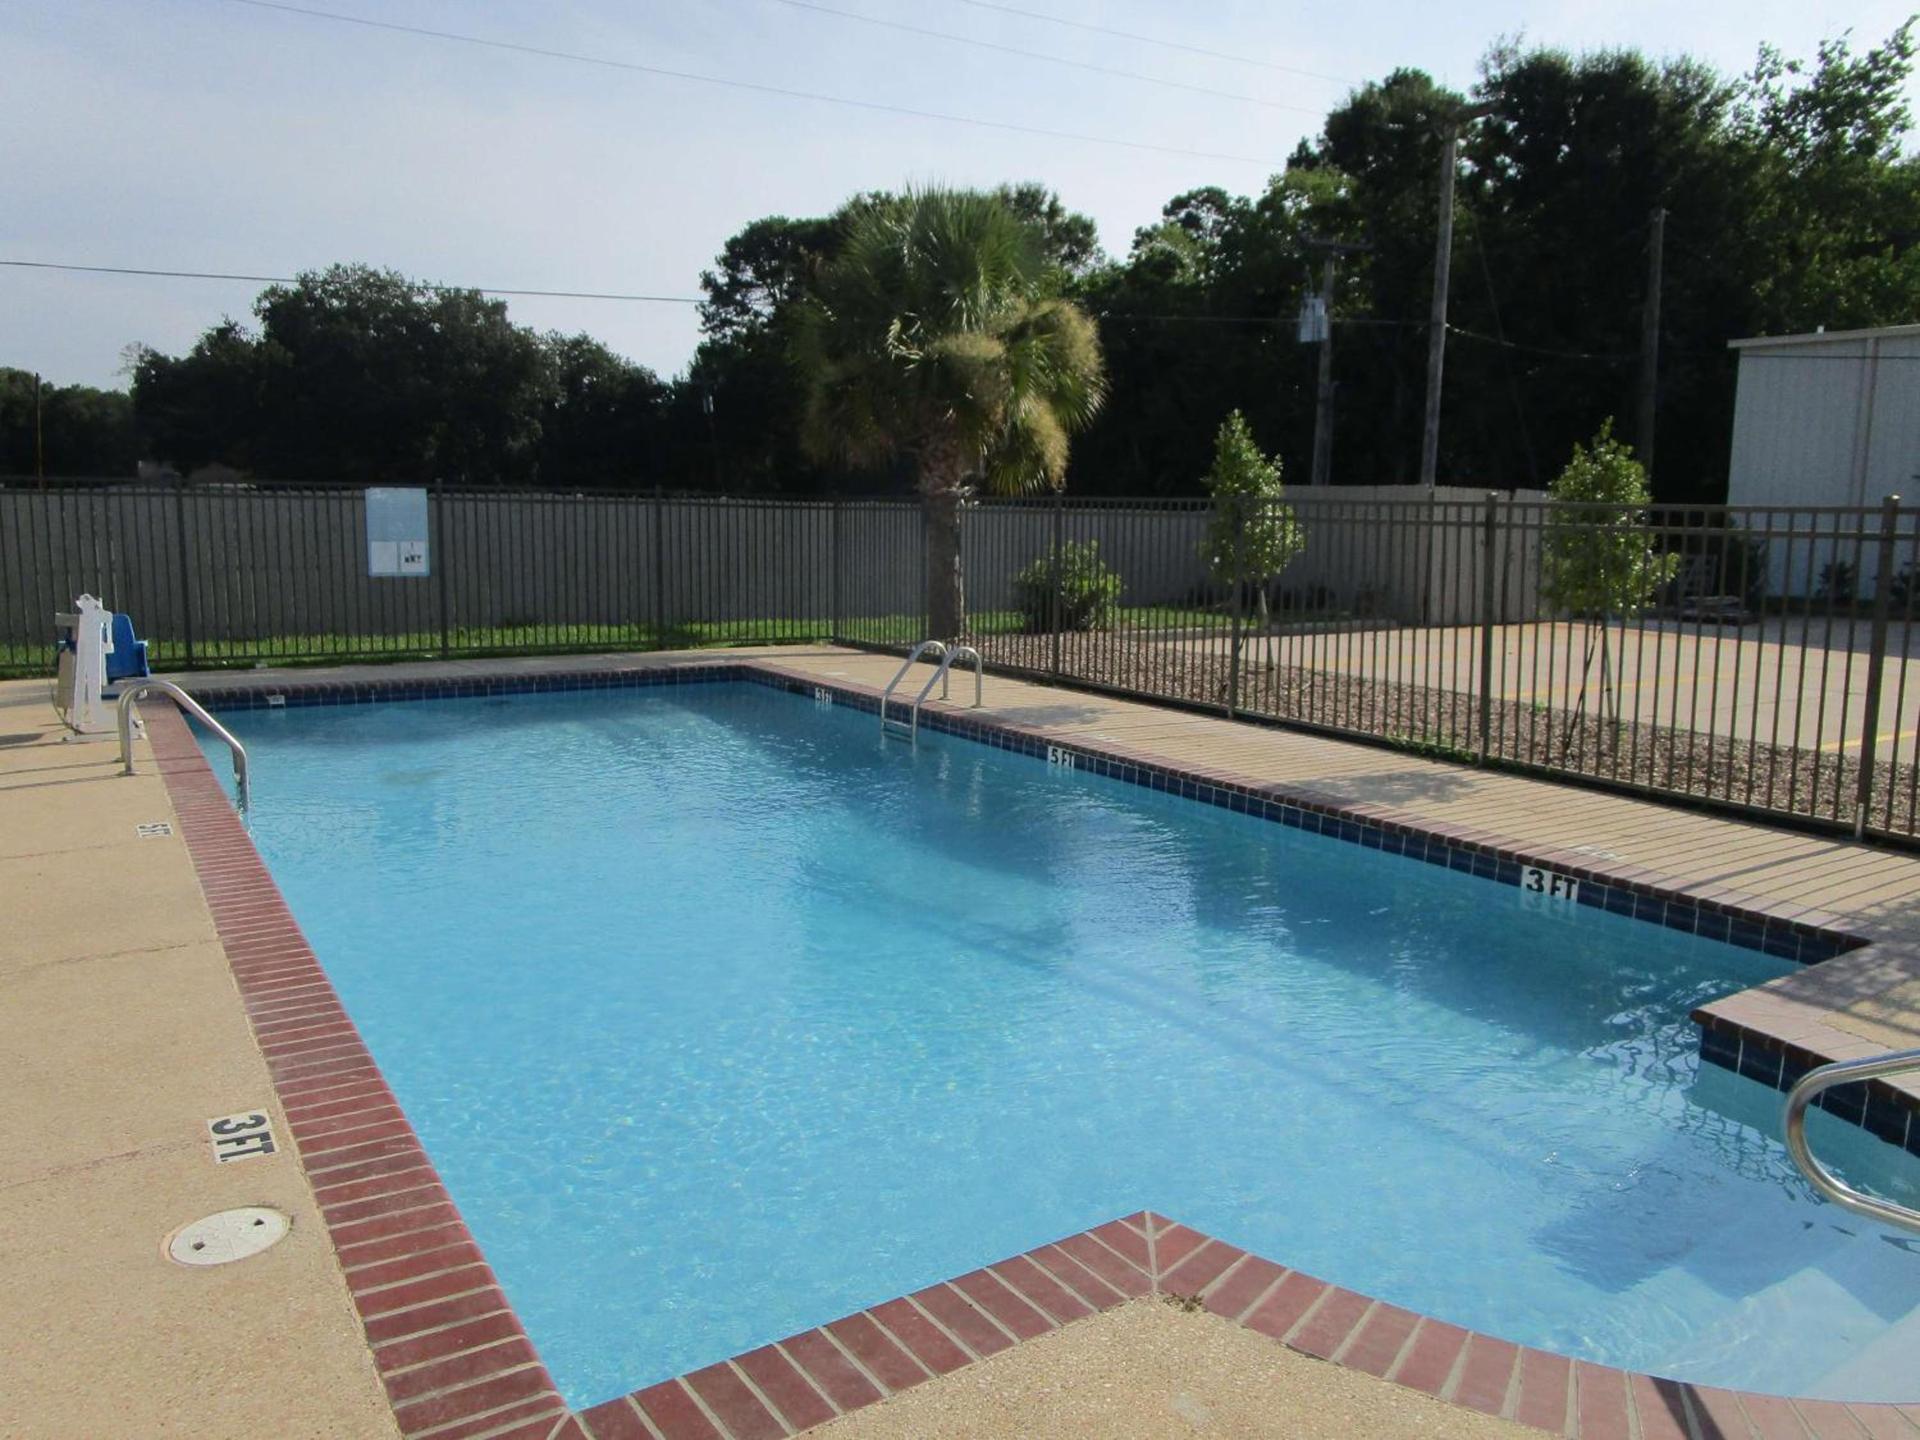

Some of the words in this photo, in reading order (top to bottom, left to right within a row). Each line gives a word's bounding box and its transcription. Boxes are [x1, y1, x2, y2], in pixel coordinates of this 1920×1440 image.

[1050, 747, 1059, 764] 5
[1061, 750, 1074, 767] FT
[1526, 869, 1544, 893] 3
[1550, 873, 1577, 900] FT
[211, 1114, 267, 1135] 3
